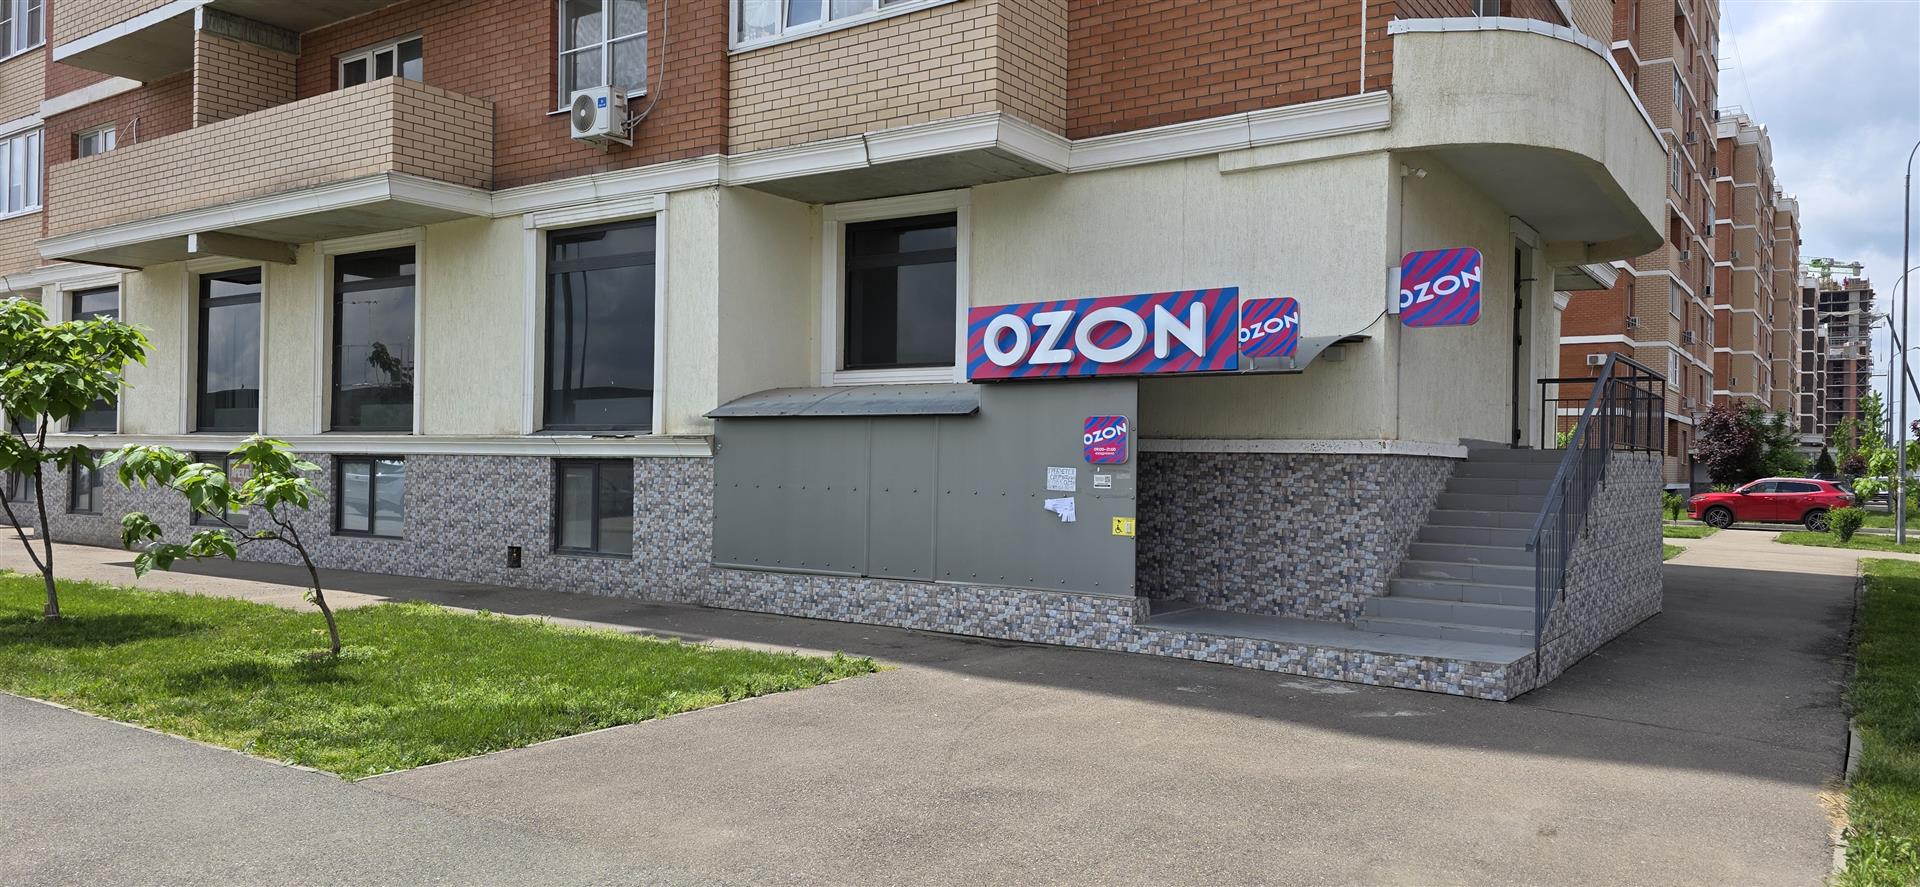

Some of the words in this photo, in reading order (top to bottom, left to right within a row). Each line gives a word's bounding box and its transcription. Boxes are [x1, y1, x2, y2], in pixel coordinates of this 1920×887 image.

[1400, 266, 1480, 308] OZON
[983, 301, 1206, 366] OZON
[1239, 311, 1298, 342] OZON
[1084, 423, 1126, 445] OZON
